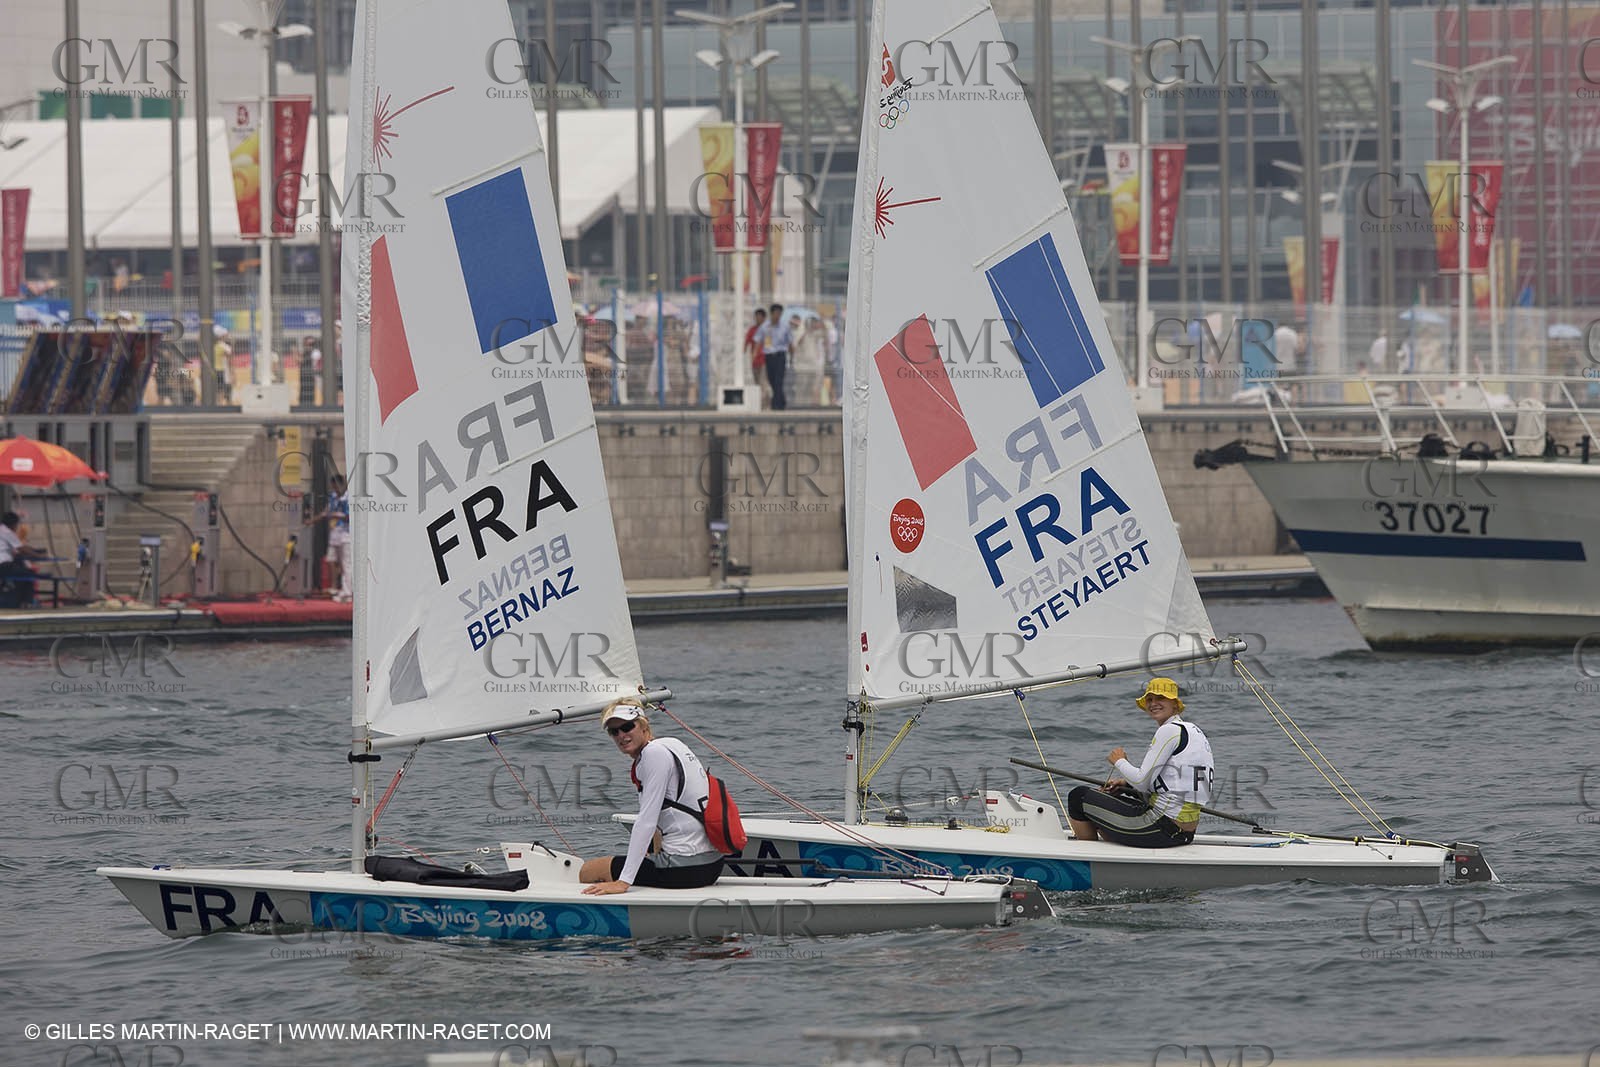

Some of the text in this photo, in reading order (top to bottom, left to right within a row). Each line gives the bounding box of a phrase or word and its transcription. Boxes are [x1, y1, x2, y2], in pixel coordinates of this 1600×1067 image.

[426, 459, 578, 585] FRA
[974, 466, 1131, 588] FRA
[1376, 501, 1489, 535] 37027
[466, 566, 579, 651] BERNAZ
[1017, 540, 1150, 641] STEYAERT
[159, 884, 286, 934] FRA
[394, 903, 548, 932] Beijing 2008
